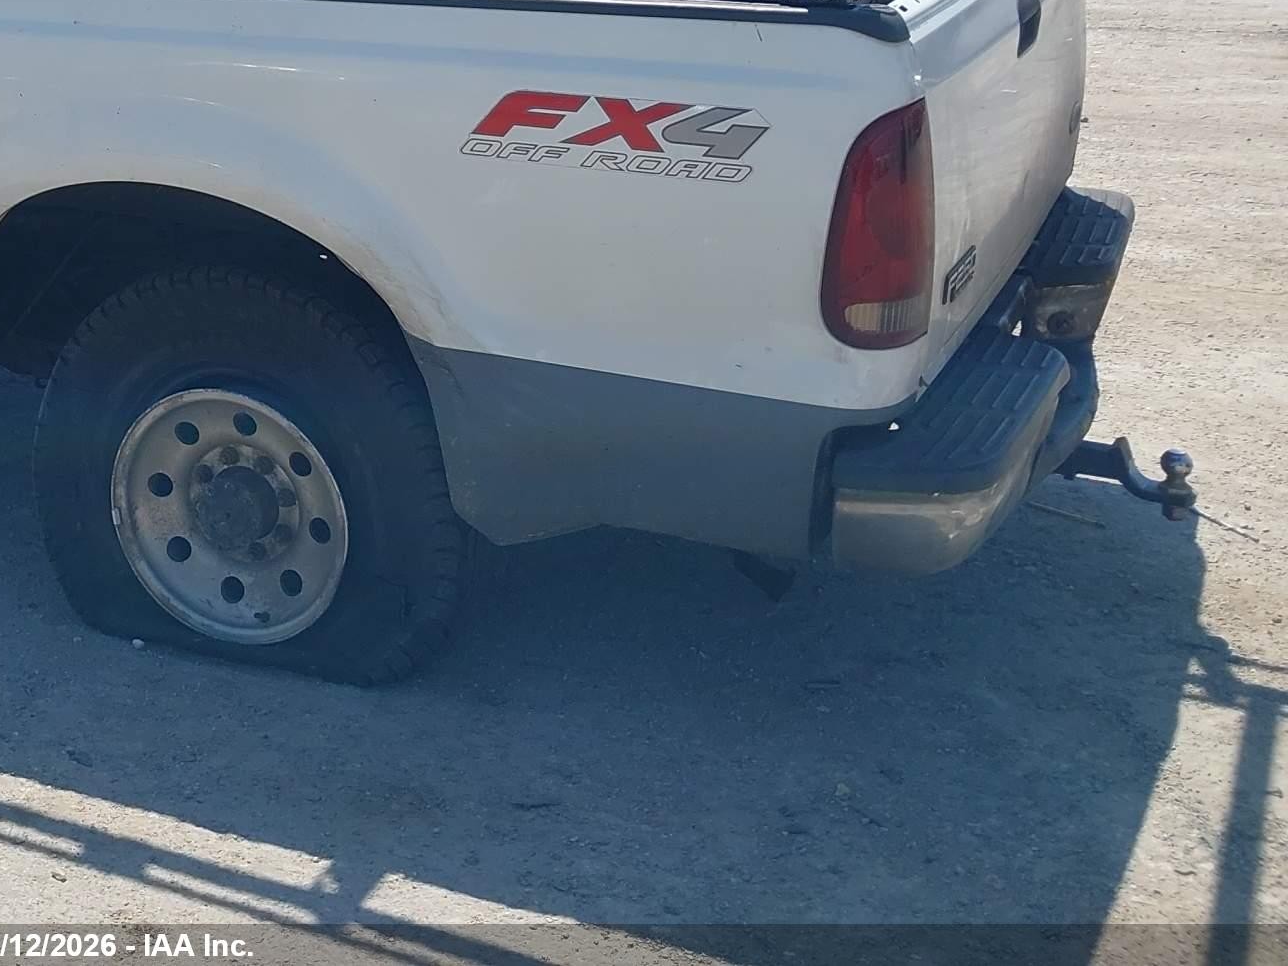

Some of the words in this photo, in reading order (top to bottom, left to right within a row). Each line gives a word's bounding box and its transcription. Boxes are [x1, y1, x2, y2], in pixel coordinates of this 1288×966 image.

[470, 90, 773, 160] FX4
[460, 137, 571, 163] OFF
[580, 150, 753, 183] ROAD
